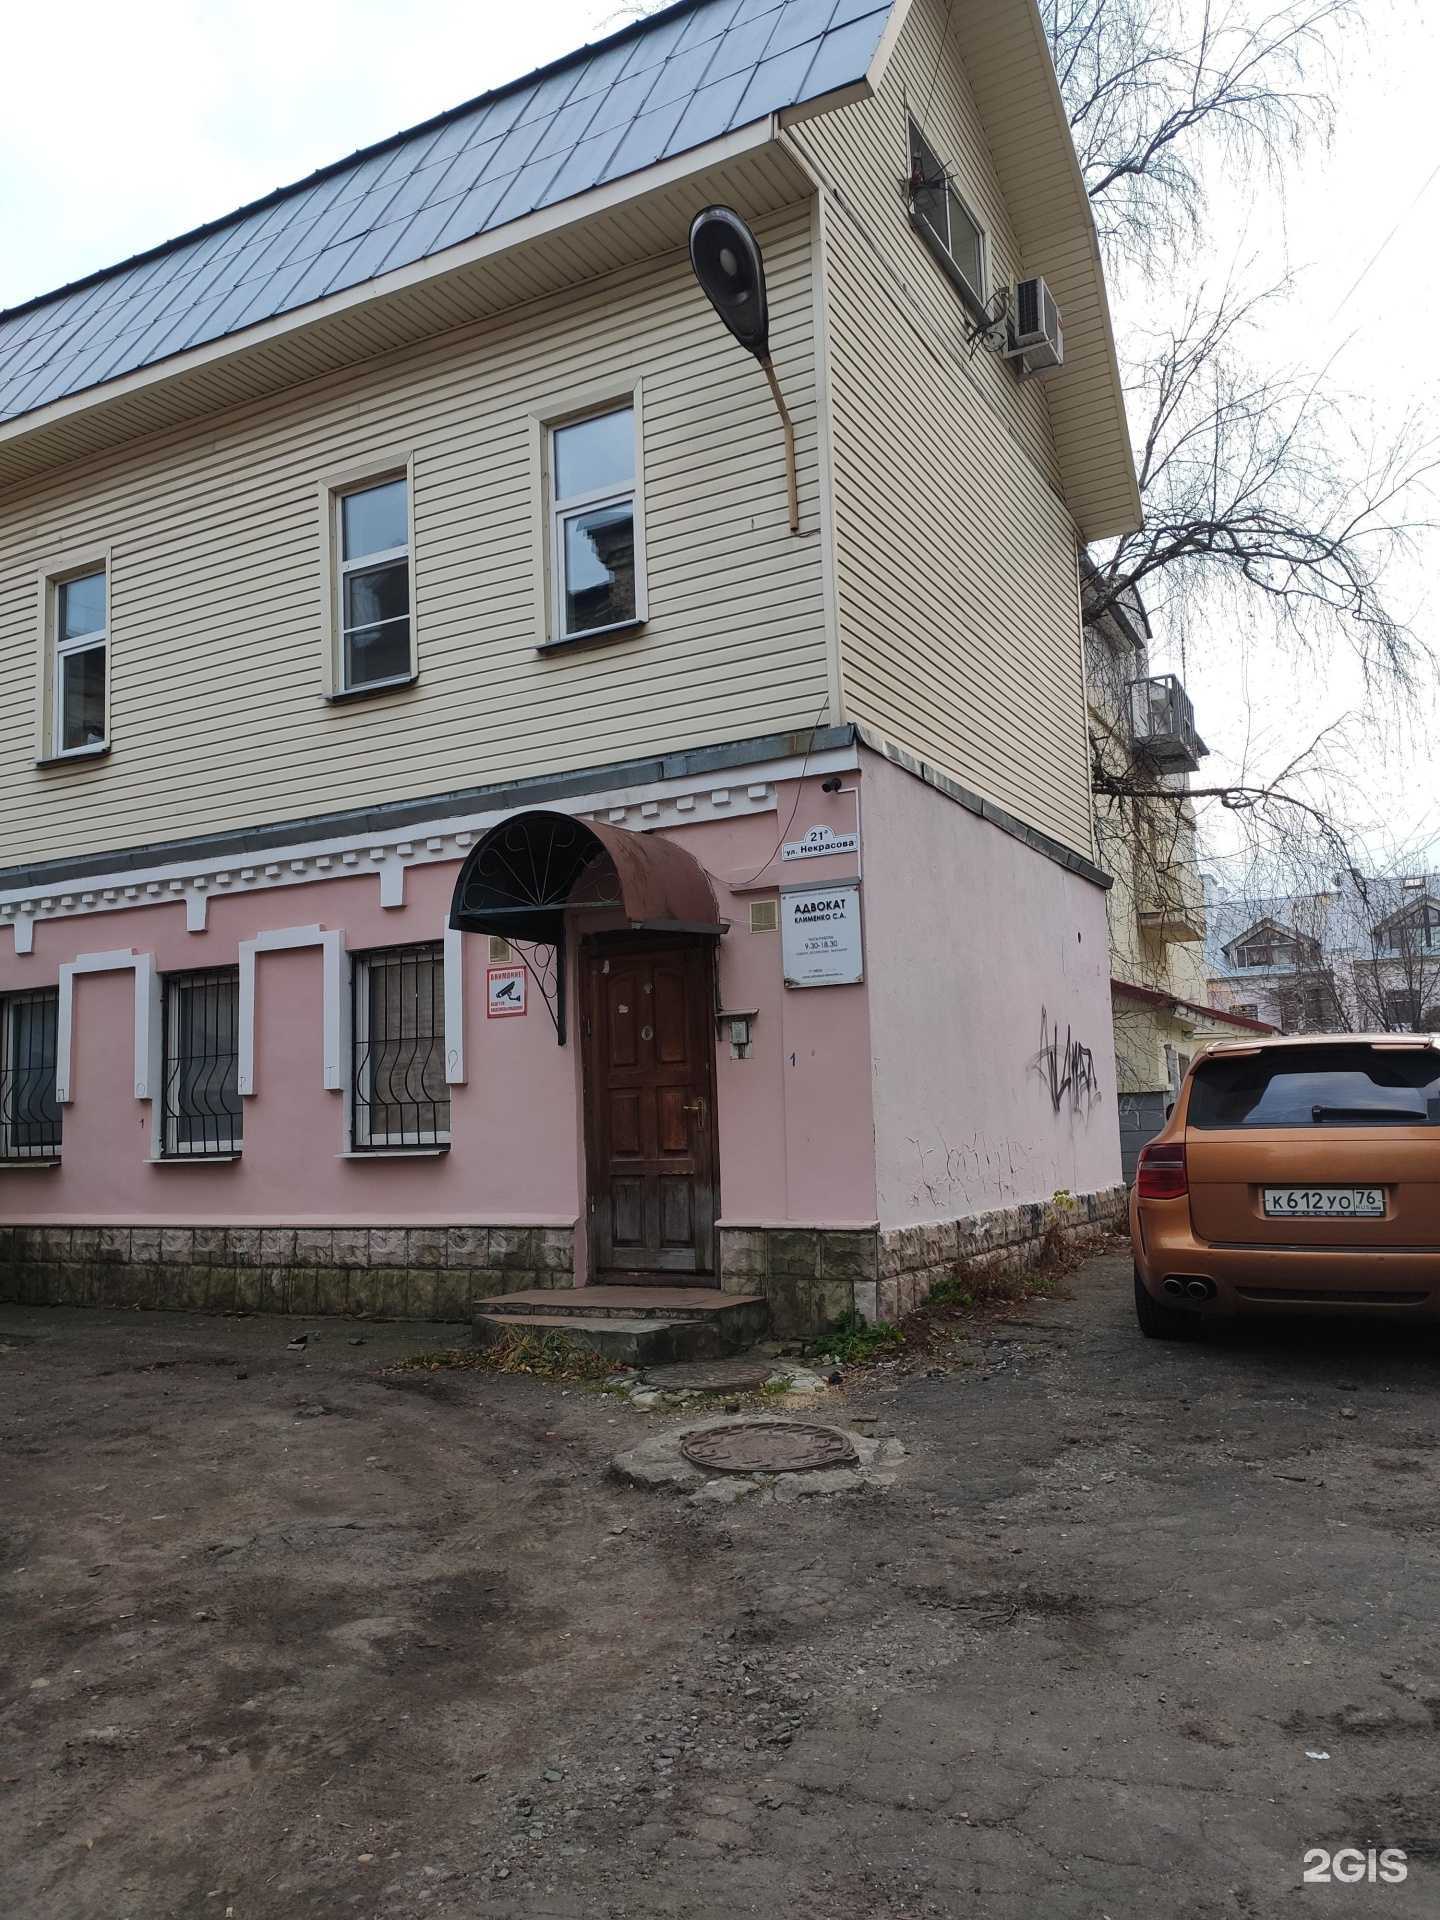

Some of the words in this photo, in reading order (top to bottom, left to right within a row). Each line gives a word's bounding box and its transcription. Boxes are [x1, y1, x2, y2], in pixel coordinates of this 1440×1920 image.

[786, 849, 798, 857] ул.
[800, 840, 854, 853] Некрасова
[794, 899, 846, 915] АДВОКАТ
[794, 914, 831, 924] КЛИМЕНКО
[832, 911, 847, 920] С.А.
[1356, 1191, 1376, 1205] 76
